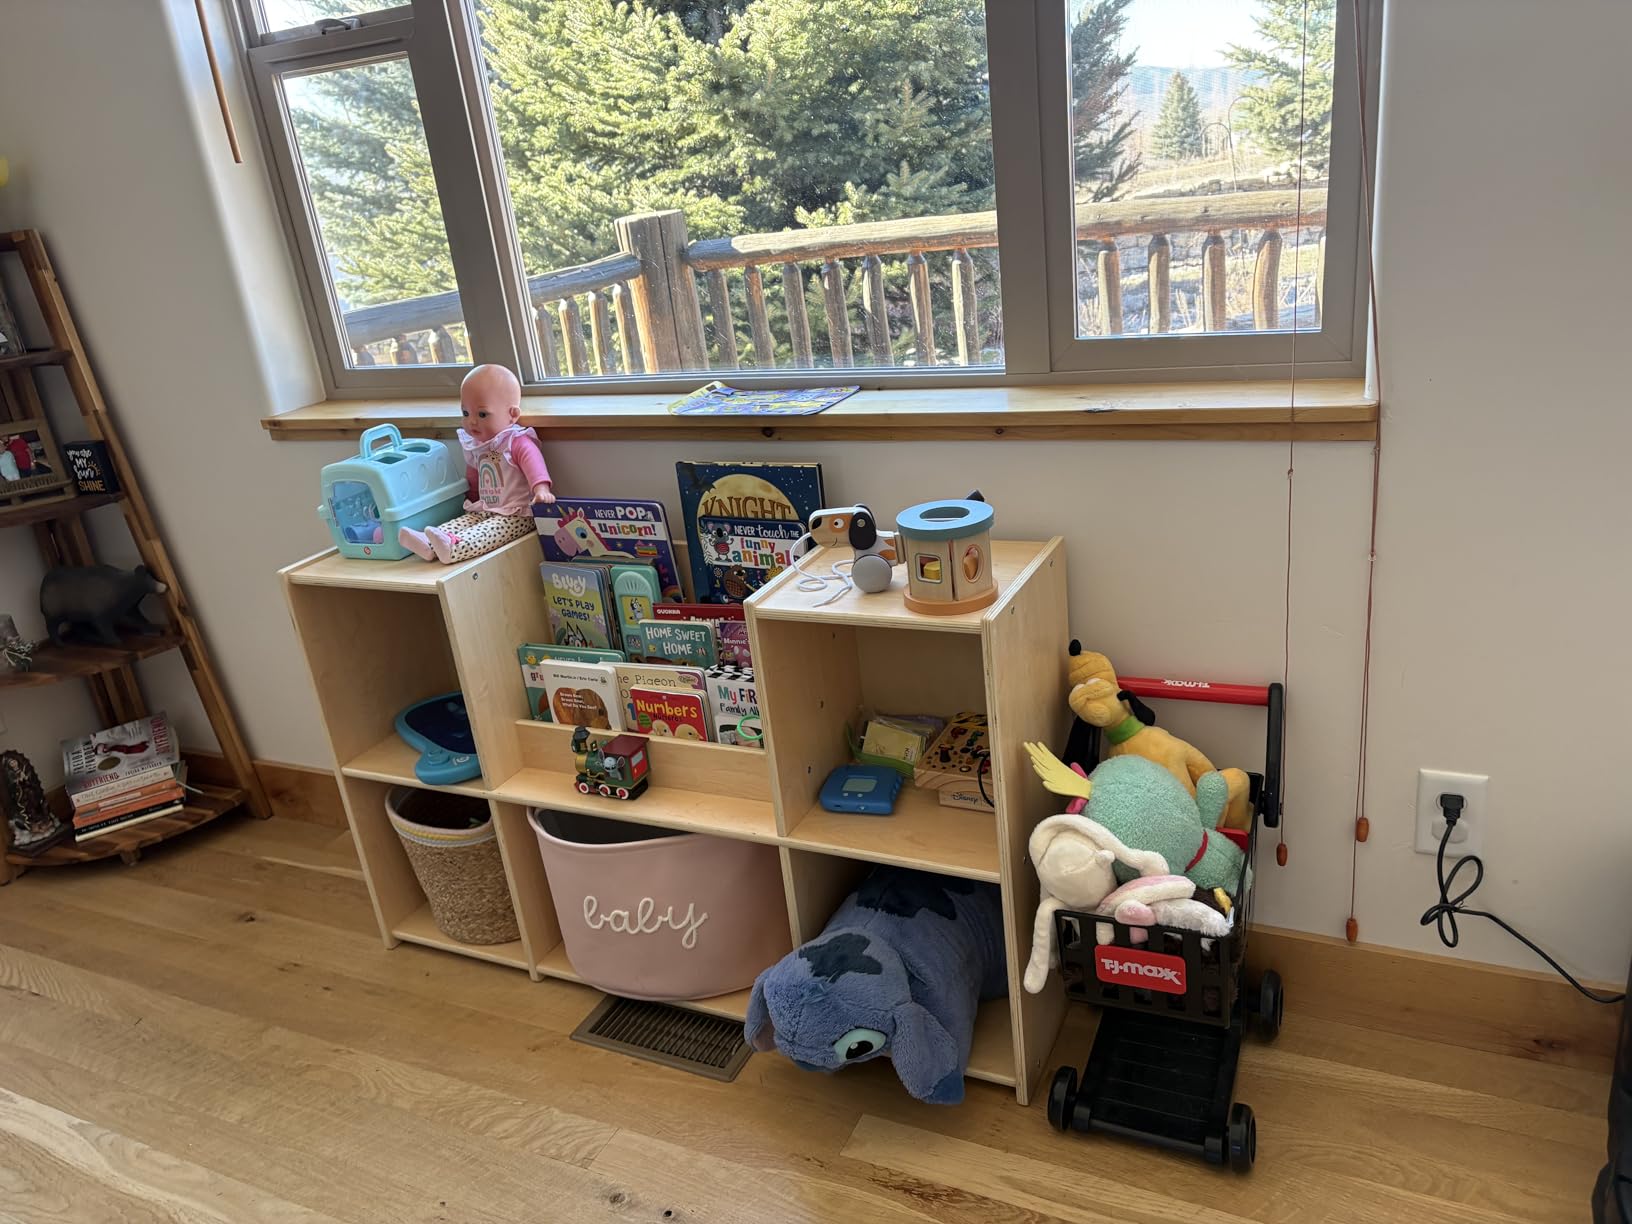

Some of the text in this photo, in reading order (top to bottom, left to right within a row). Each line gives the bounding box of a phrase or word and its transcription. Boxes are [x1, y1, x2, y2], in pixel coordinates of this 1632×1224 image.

[75, 458, 87, 468] MY
[78, 480, 106, 491] SHINE
[594, 509, 616, 519] NEVER
[615, 506, 645, 519] POP
[702, 496, 791, 519] KNIGHT
[598, 522, 657, 536] unicorn!
[734, 525, 800, 539] NEVER touch THE
[740, 538, 775, 553] funny
[645, 626, 706, 642] HOME SWEET
[662, 642, 693, 655] HOME
[718, 685, 737, 705] My
[636, 699, 698, 718] Numbers
[720, 702, 747, 716] Family
[583, 895, 708, 949] baby
